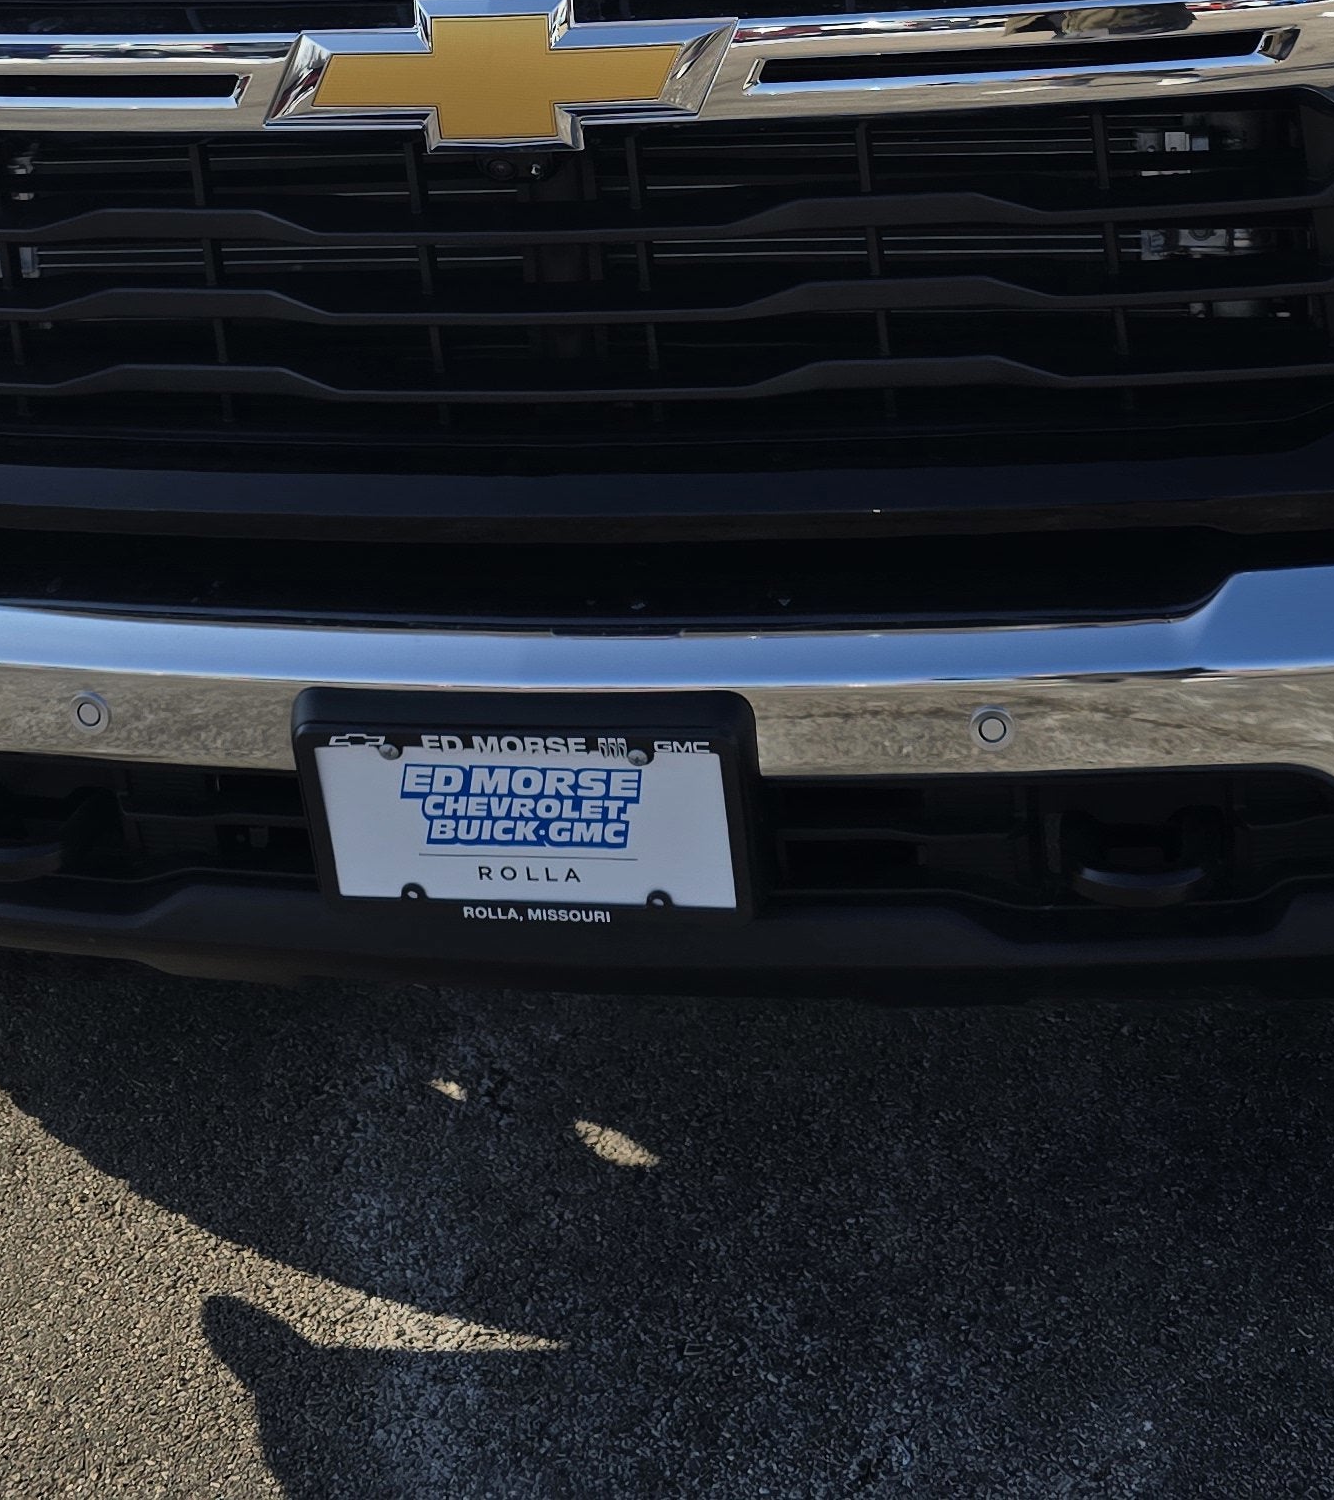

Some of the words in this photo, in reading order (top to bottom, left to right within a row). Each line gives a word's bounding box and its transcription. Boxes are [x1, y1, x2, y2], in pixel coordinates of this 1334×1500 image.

[420, 735, 465, 754] ED
[472, 736, 586, 756] MORSE
[653, 740, 710, 754] GMC
[402, 766, 464, 794] ED
[469, 767, 639, 798] MORSE
[424, 795, 624, 820] CHEVROLET
[477, 865, 581, 883] ROLLA
[463, 906, 524, 922] ROLLA,
[527, 908, 611, 923] MISSOURI
